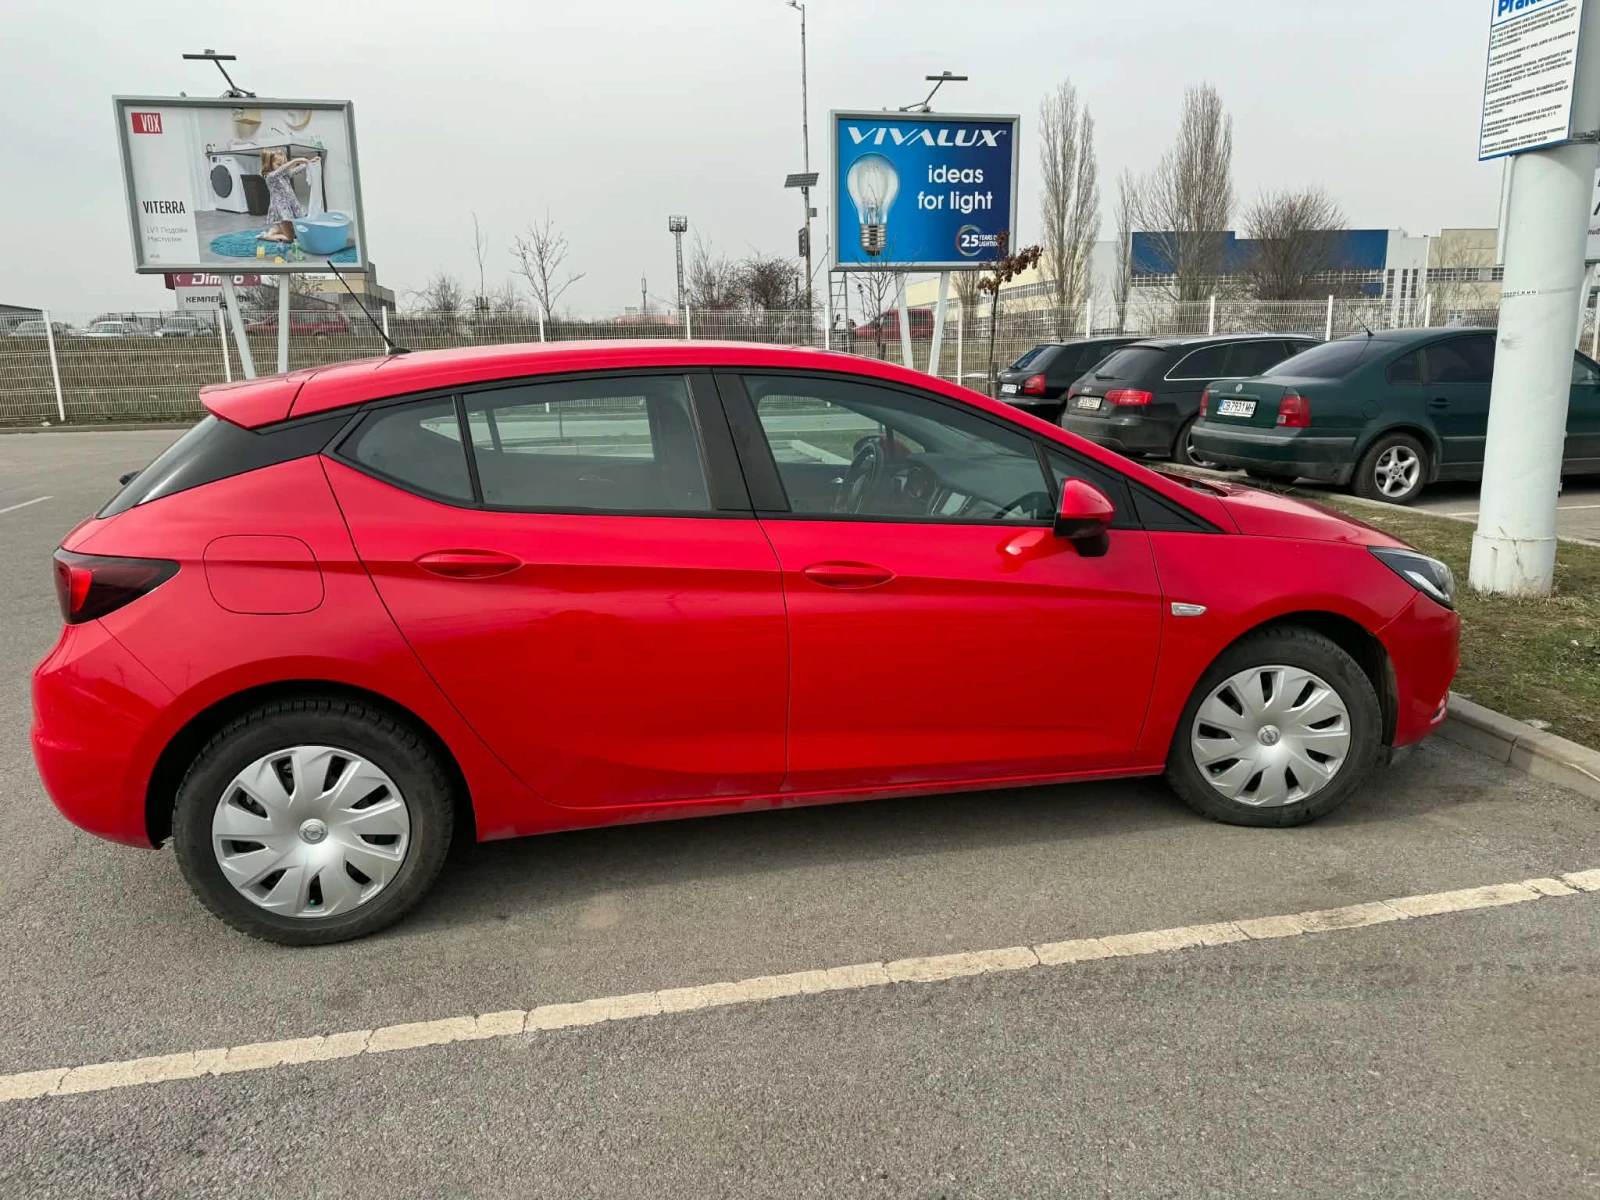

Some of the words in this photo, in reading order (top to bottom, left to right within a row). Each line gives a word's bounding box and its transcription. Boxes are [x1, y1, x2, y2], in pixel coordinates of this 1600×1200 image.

[141, 114, 160, 132] VOX
[928, 164, 984, 184] ideas
[142, 200, 186, 214] VITERRA
[917, 191, 945, 210] for
[950, 191, 993, 214] light
[961, 234, 979, 247] 25
